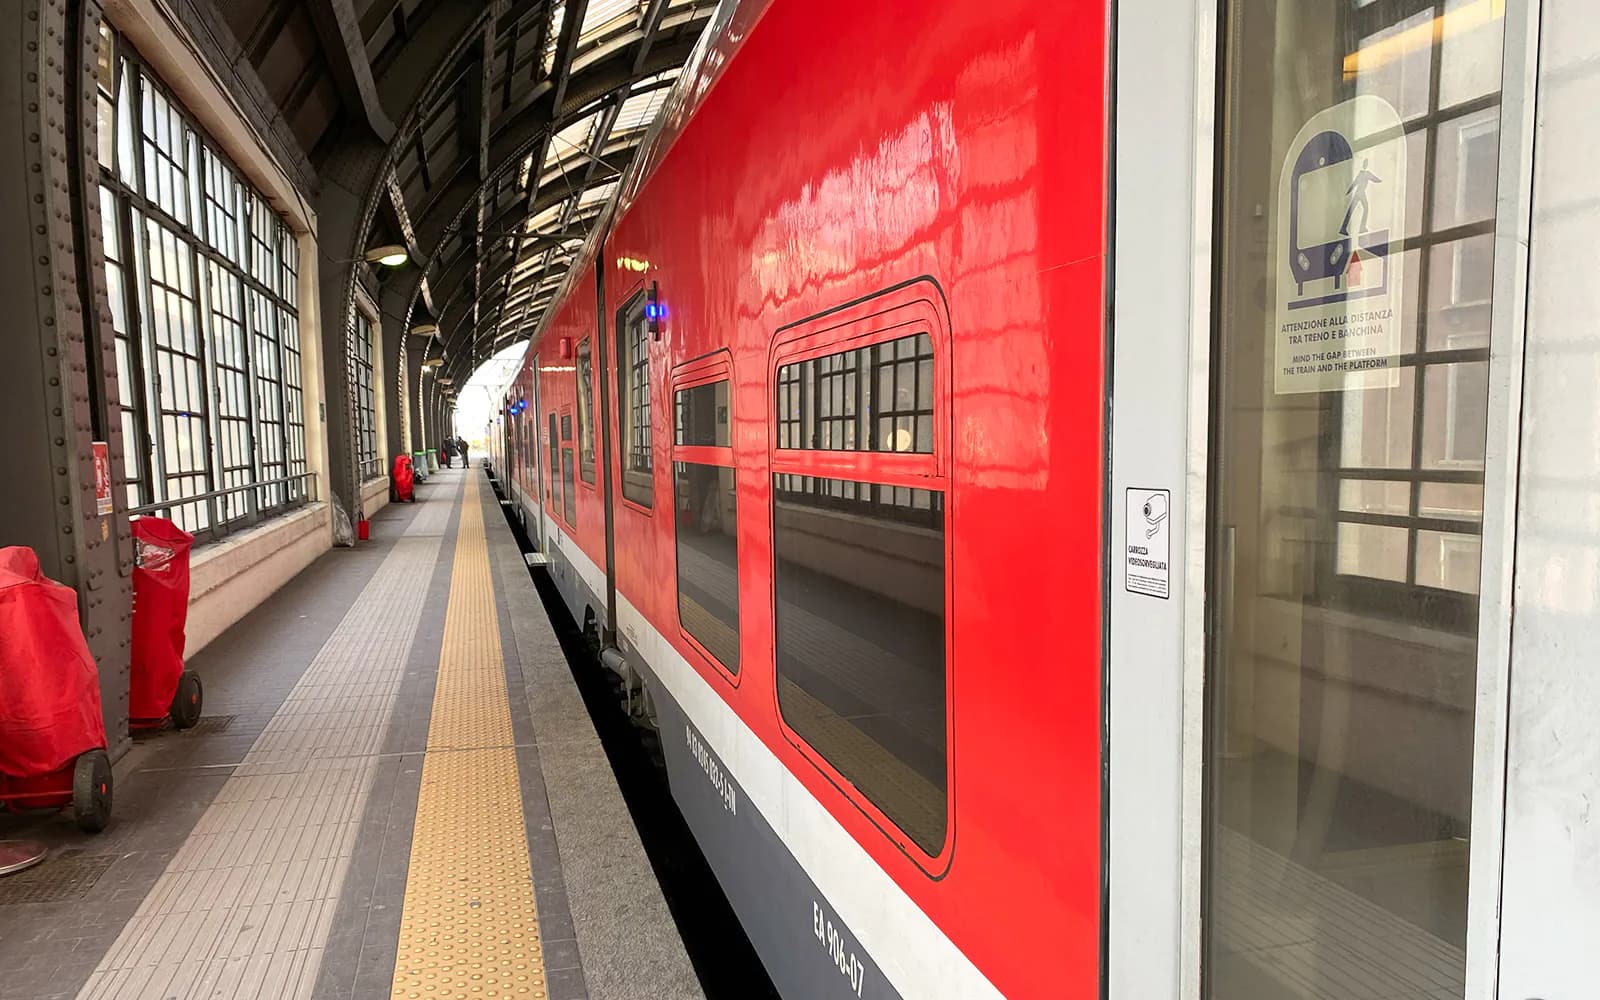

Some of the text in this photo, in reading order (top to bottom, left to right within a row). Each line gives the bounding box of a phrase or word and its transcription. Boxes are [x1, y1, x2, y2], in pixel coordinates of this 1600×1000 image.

[1281, 309, 1393, 333] ATTENZIONE ALLA DISTANZA
[1289, 324, 1383, 345] TRA TRENO E BANCHINA
[1292, 347, 1376, 364] MIND THE GAP BETWEEN
[1283, 358, 1388, 376] THE TRAIN AND THE PLATFORM
[813, 900, 864, 998] EA 906-07
